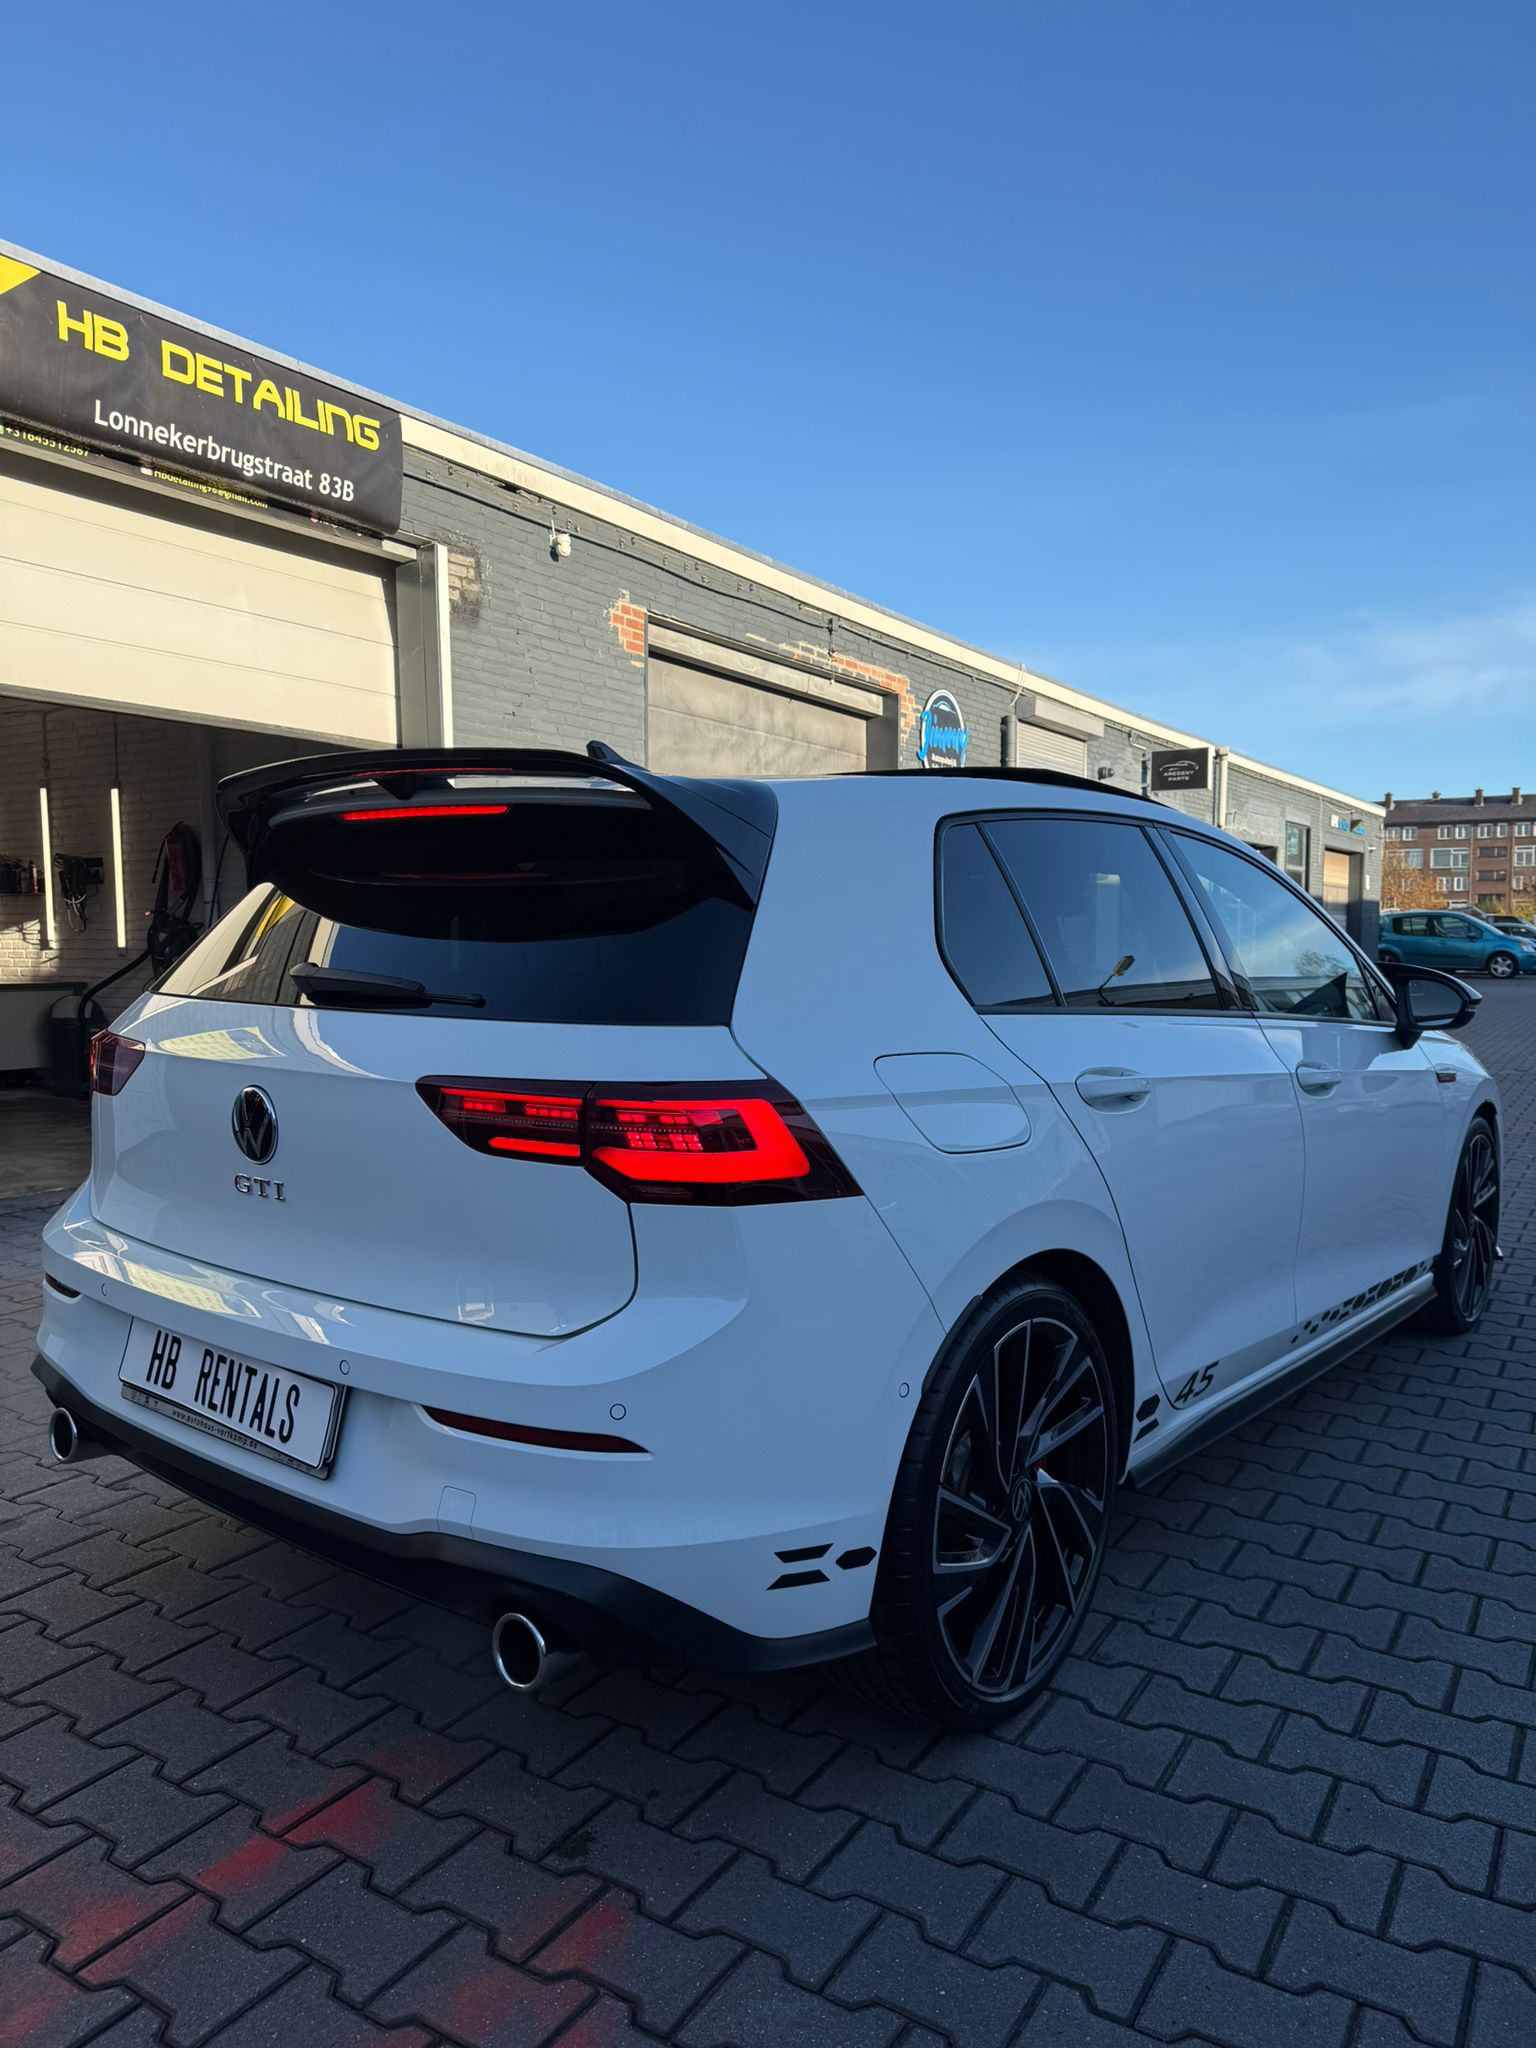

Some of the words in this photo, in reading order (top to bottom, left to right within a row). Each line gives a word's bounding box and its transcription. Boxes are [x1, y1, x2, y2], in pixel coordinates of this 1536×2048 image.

[57, 300, 130, 361] HB
[161, 339, 380, 451] DETAILING
[94, 399, 313, 491] Lonnekerbrugstraat
[319, 473, 355, 502] 83B
[234, 1173, 286, 1201] GTI
[145, 1329, 182, 1390] HB
[193, 1347, 300, 1444] RENTALS
[1174, 1360, 1219, 1404] 45
